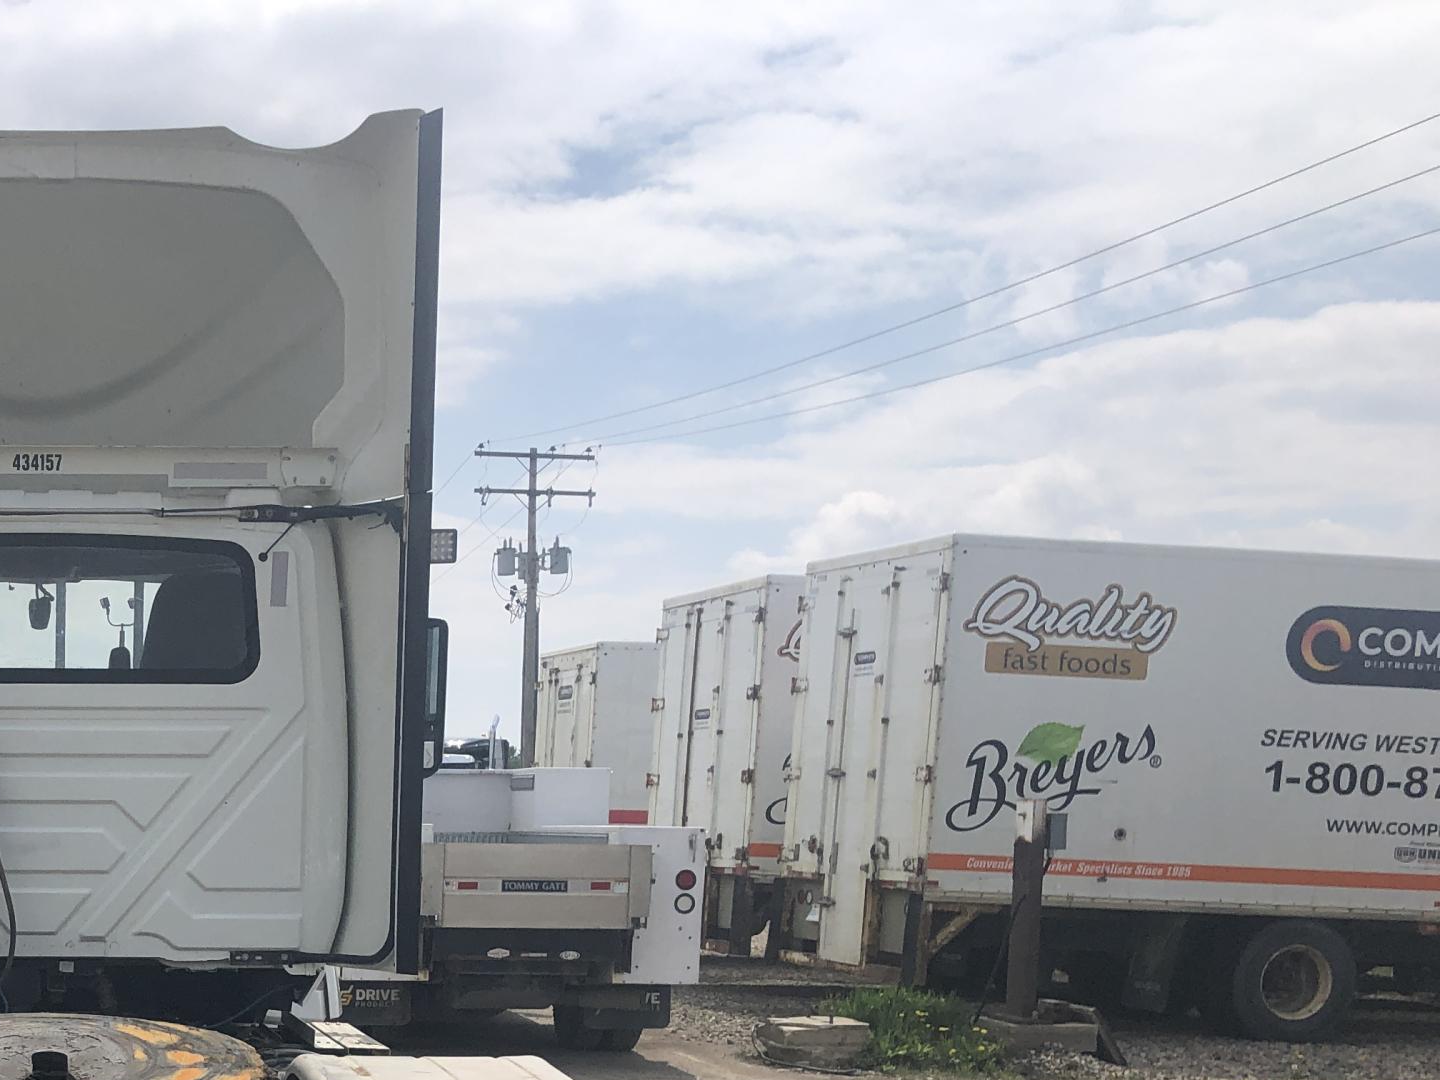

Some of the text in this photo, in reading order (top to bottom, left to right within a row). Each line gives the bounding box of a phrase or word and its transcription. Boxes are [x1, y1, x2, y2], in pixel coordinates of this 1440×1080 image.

[12, 453, 62, 471] 434157
[963, 575, 1176, 654] Quality
[1003, 648, 1131, 675] fast foods
[1261, 729, 1440, 755] SERVING WEST
[504, 882, 566, 891] TOMMY GATE
[356, 988, 400, 1001] DRIVE
